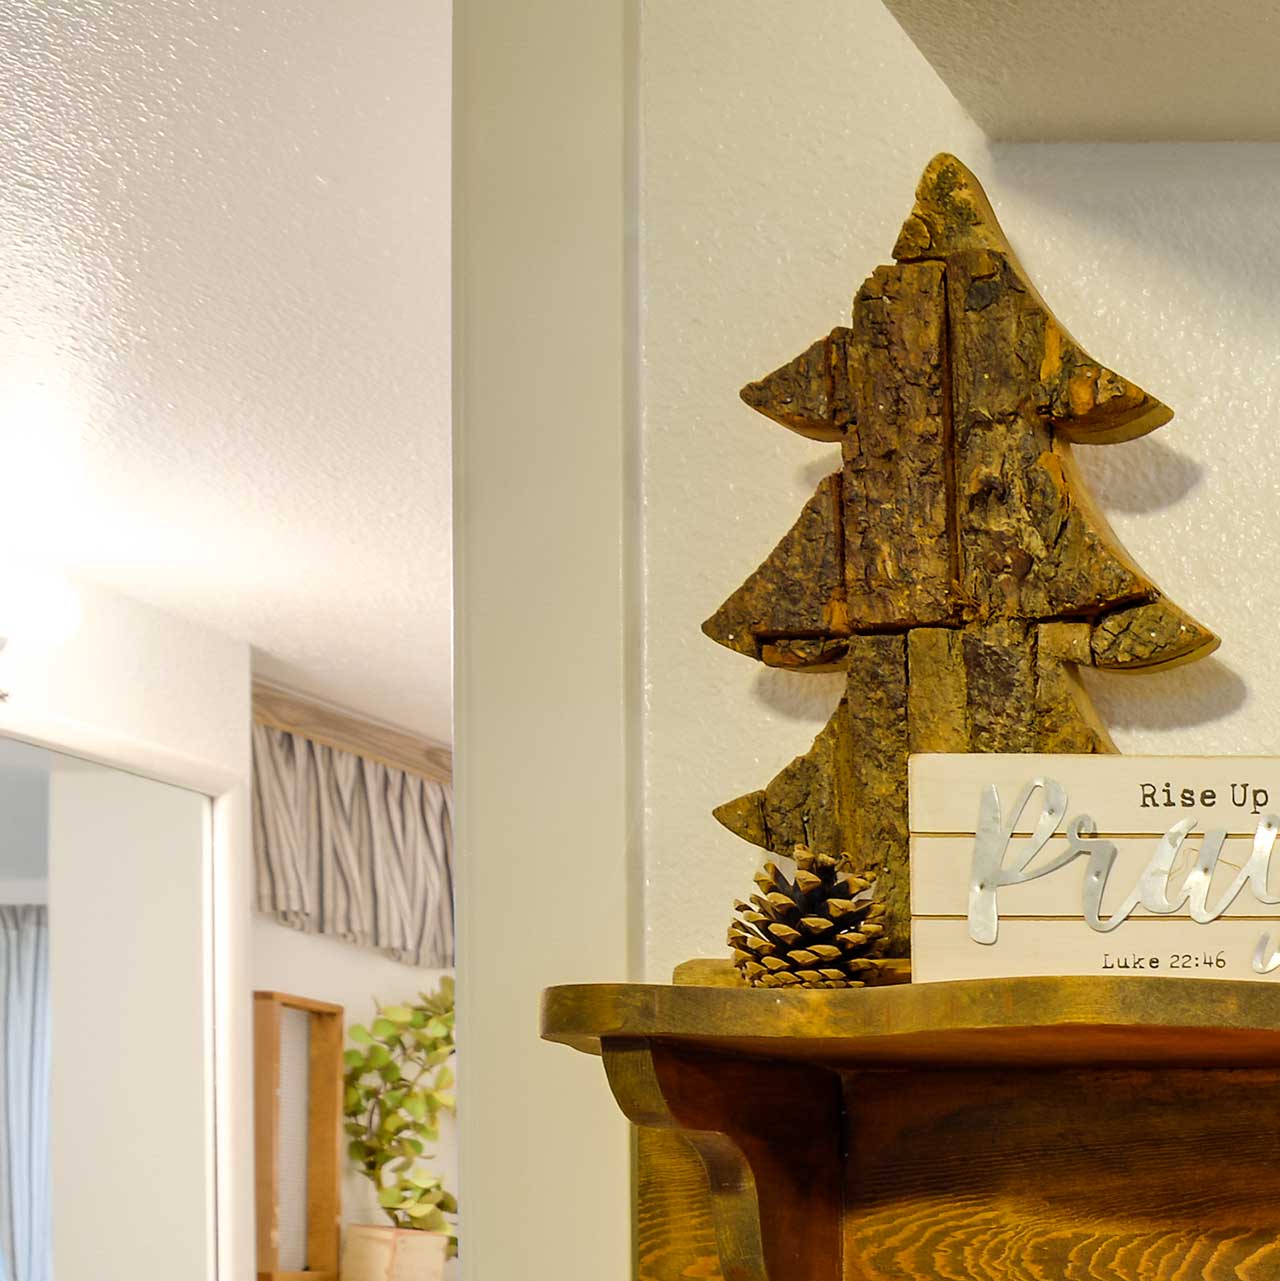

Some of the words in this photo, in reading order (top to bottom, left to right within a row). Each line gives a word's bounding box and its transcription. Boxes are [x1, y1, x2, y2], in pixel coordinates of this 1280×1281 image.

[1139, 783, 1217, 808] Rise
[1230, 783, 1270, 814] Up
[1102, 953, 1159, 969] Luke
[1169, 952, 1227, 969] 22:46
